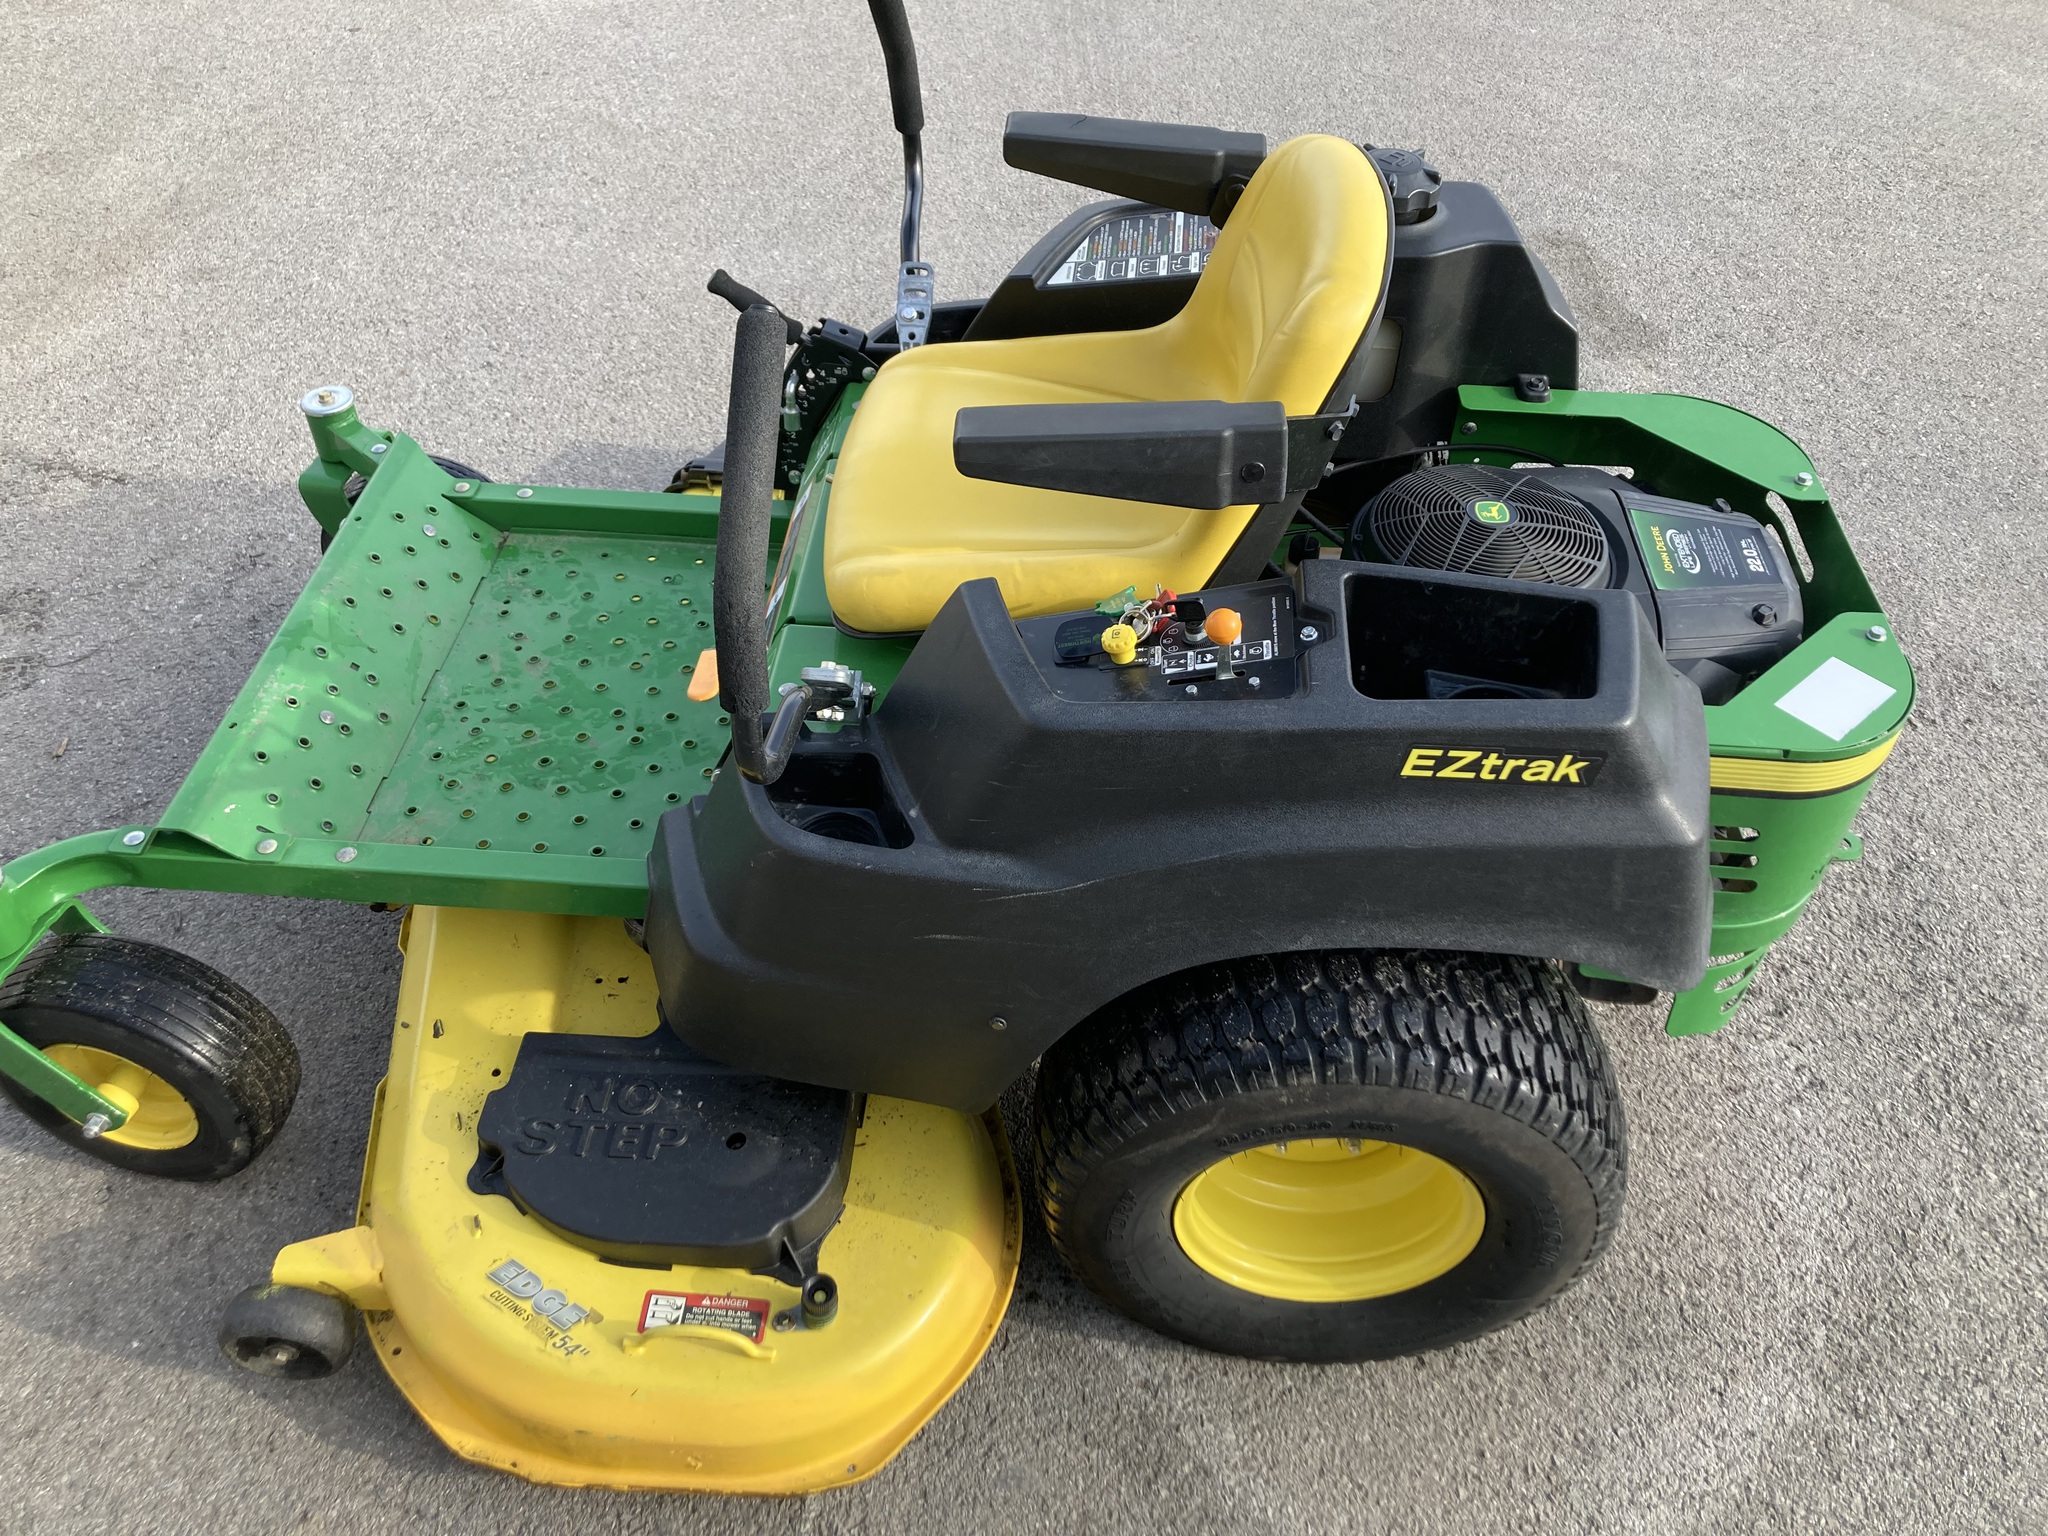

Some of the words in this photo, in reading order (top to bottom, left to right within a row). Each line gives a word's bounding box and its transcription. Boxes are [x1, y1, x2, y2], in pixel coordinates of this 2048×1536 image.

[802, 400, 808, 408] 3
[790, 431, 797, 439] 2
[1651, 525, 1667, 552] DEERE
[1672, 532, 1691, 568] EXTENDED
[1660, 545, 1675, 574] JOHN
[1743, 549, 1765, 573] 22.0
[1400, 748, 1590, 783] EZtrak
[569, 1074, 663, 1116] NO
[514, 1119, 690, 1160] STEP
[485, 1258, 590, 1331] EDGE
[490, 1289, 527, 1318] CUTTING
[711, 1296, 749, 1308] DANGER
[692, 1307, 727, 1316] ROTATING
[727, 1309, 750, 1318] BLADE
